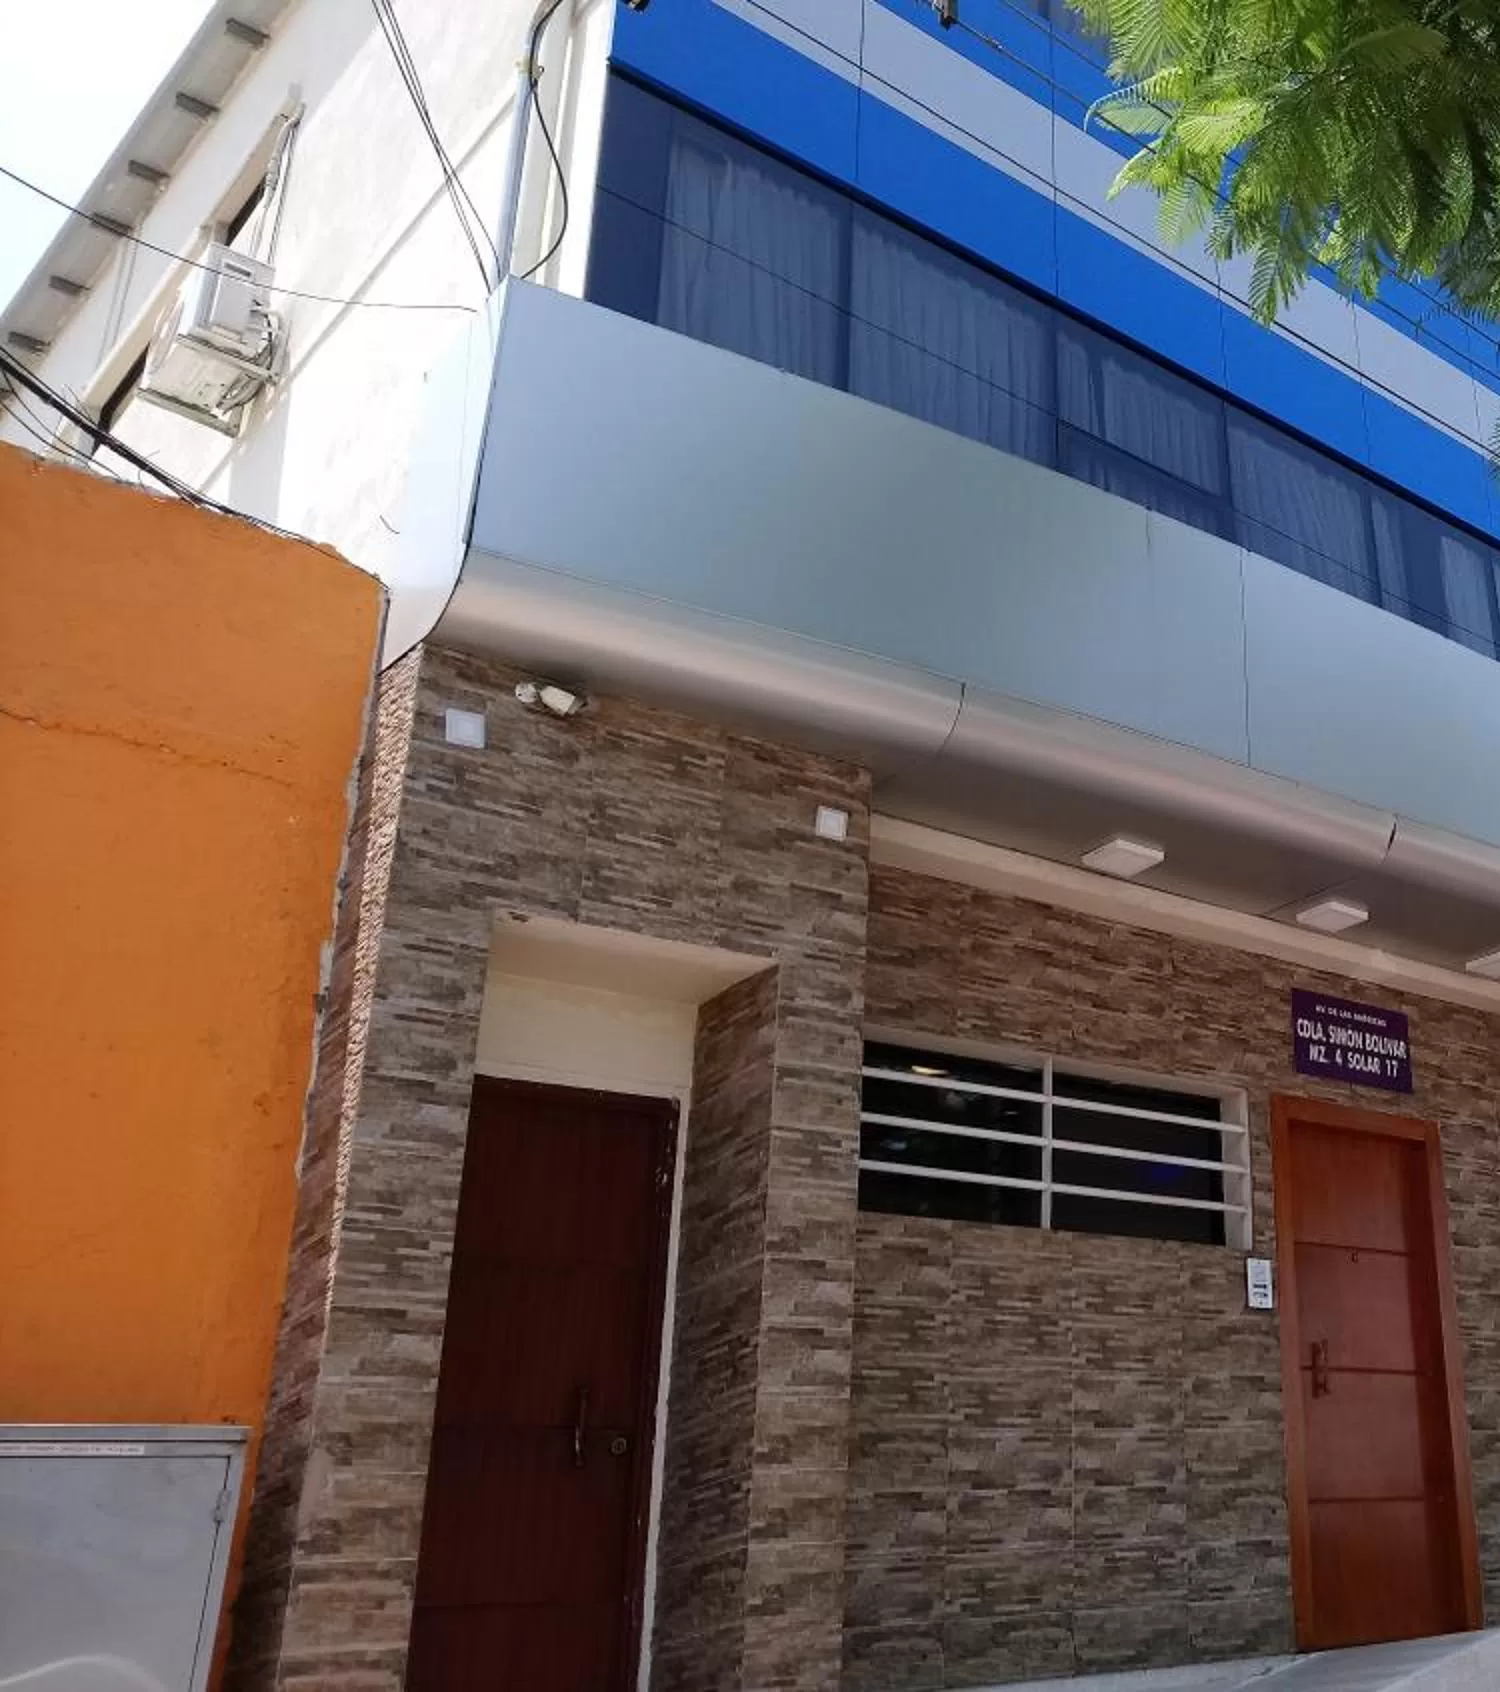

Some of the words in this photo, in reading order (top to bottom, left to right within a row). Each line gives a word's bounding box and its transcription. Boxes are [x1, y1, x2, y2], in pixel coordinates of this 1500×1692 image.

[1297, 1018, 1326, 1042] CDLA.
[1335, 1048, 1343, 1067] 4
[1347, 1051, 1381, 1075] SOLAR
[1384, 1060, 1399, 1078] 17
